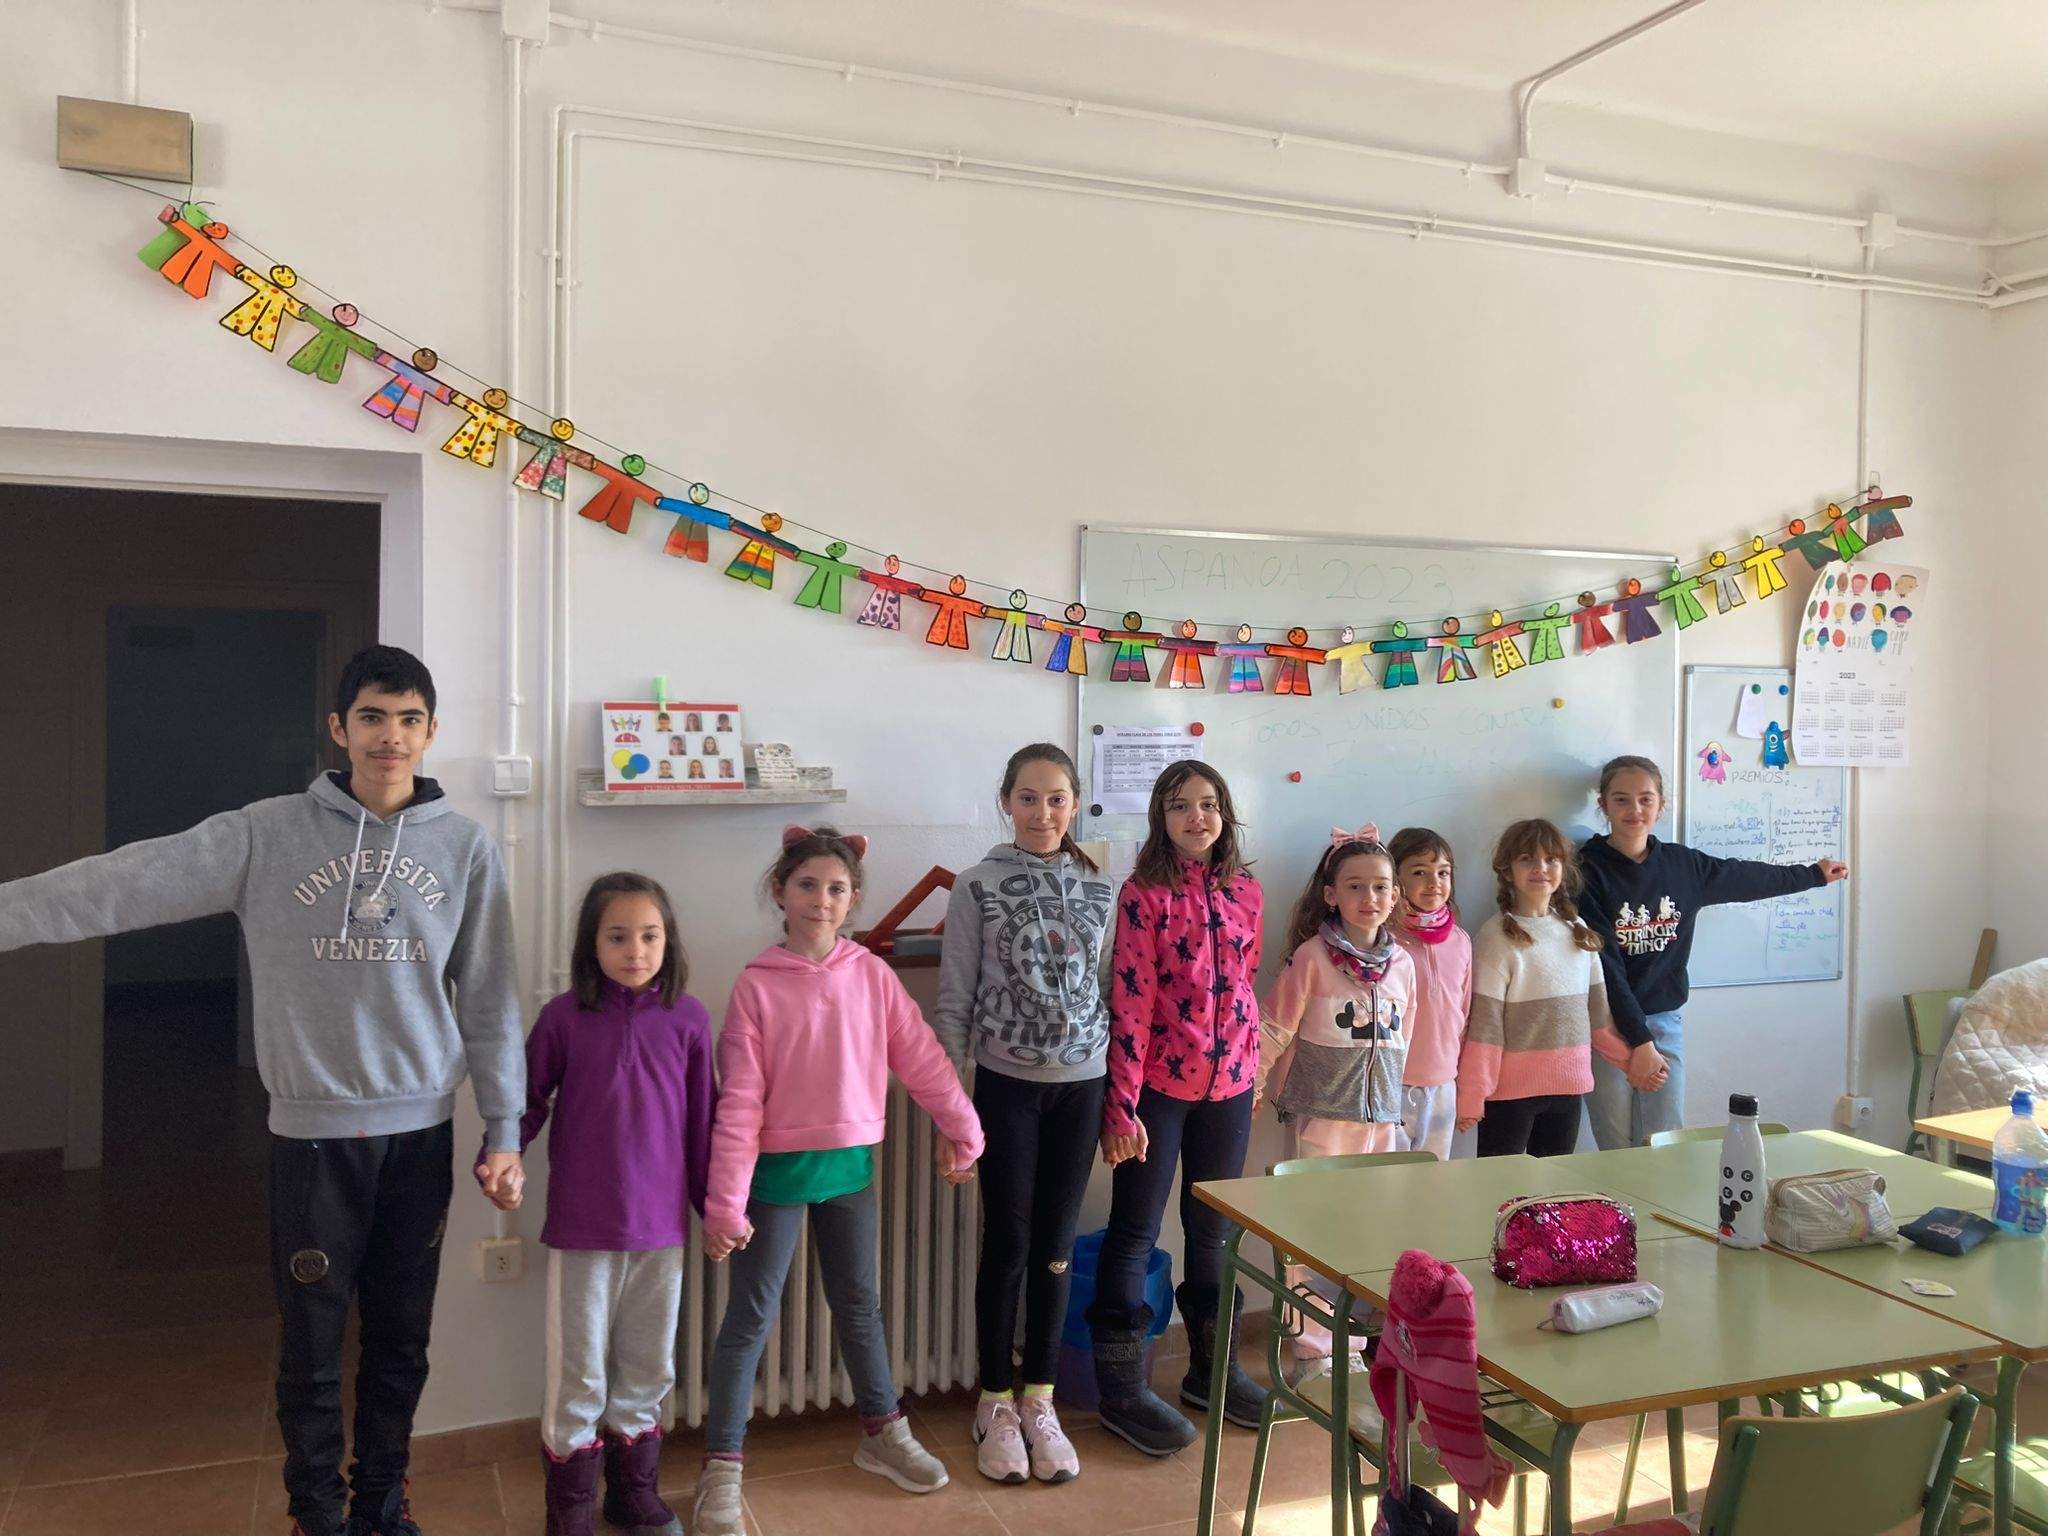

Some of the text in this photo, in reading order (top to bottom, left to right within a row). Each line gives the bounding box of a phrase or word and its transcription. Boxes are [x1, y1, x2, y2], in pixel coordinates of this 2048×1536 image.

[1838, 672, 1857, 680] 2023
[969, 871, 1112, 903] LOVE
[310, 937, 428, 963] VENEZIA
